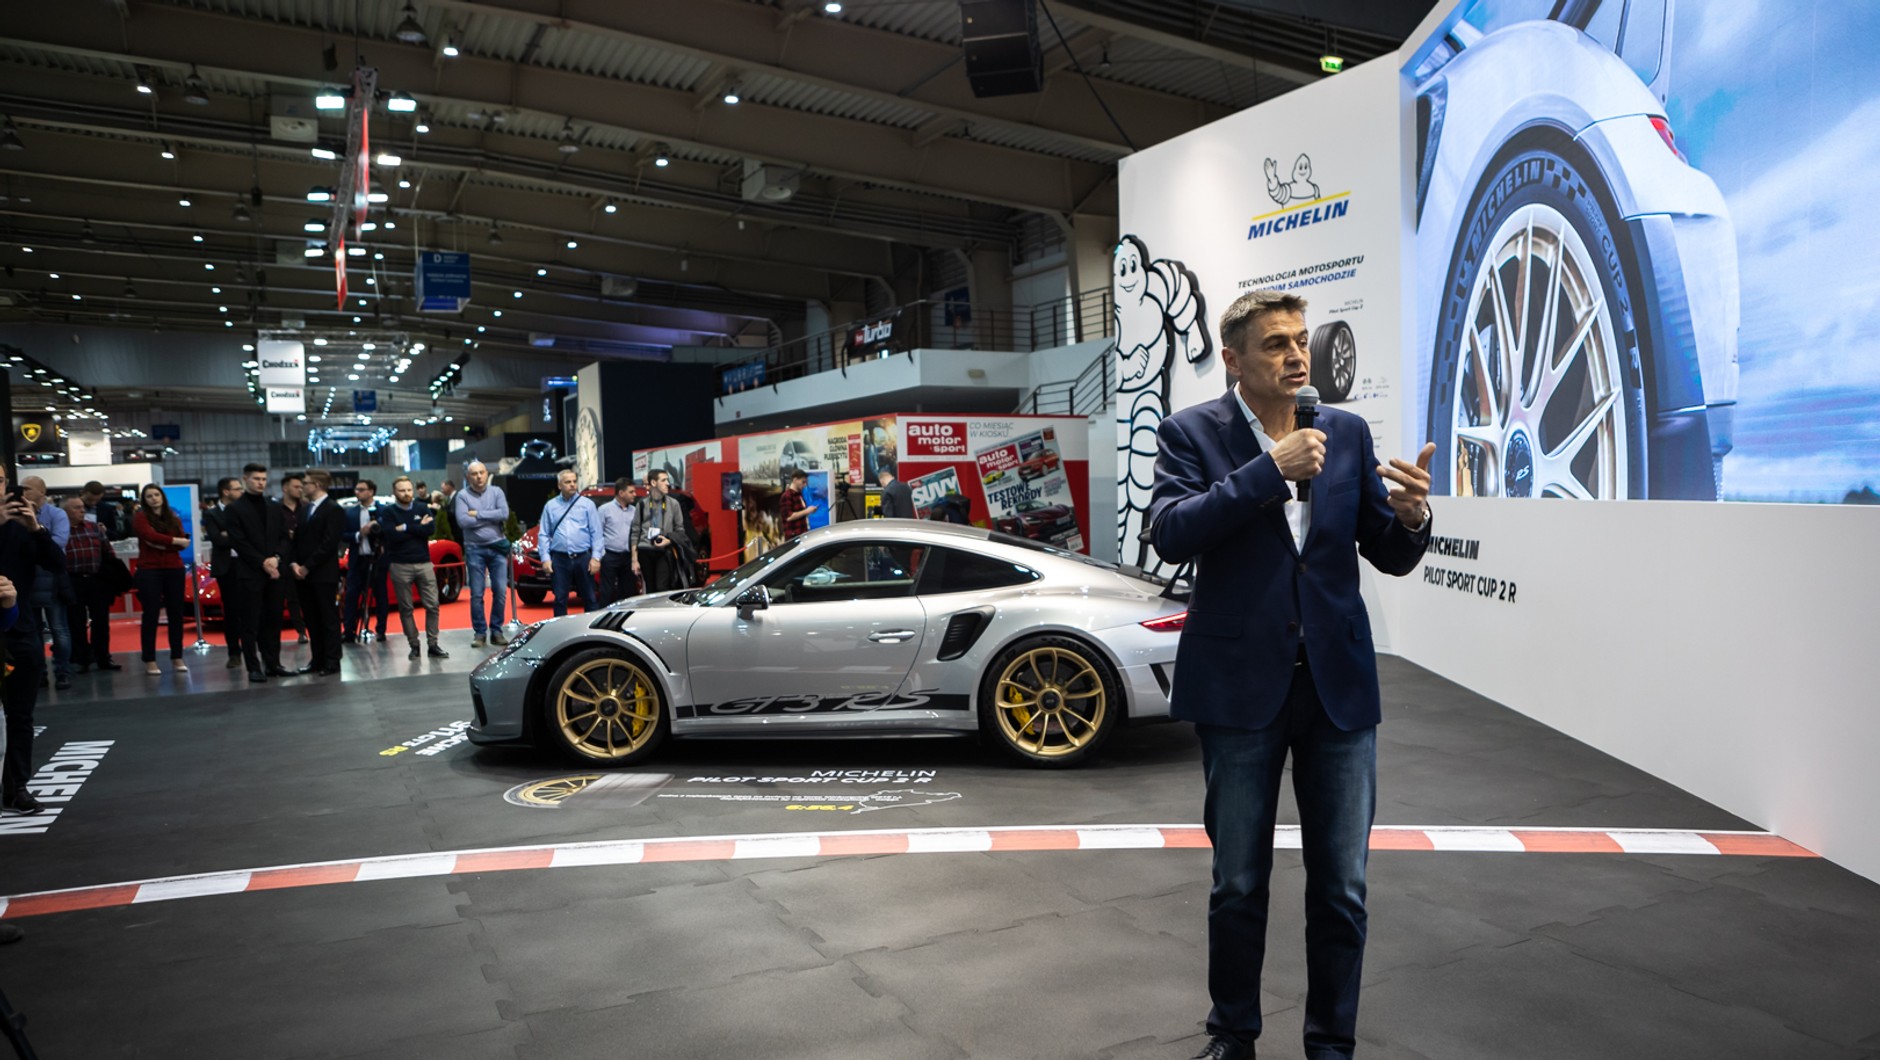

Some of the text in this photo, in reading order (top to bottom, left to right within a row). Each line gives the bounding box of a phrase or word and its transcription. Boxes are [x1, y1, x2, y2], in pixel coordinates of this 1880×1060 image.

[1248, 200, 1349, 240] MICHELIN
[1471, 160, 1541, 258] MICHELIN
[1238, 255, 1365, 290] TECHNOLOGIA MOTOSPORTU
[1287, 268, 1357, 291] SAMOCHODZIE
[1602, 234, 1623, 290] CUP
[1618, 298, 1630, 316] 2
[908, 424, 953, 436] auto
[918, 435, 962, 445] motor
[932, 445, 966, 453] sport
[979, 449, 1009, 465] auto
[987, 455, 1015, 469] motor
[911, 475, 957, 506] SUVY
[987, 482, 1031, 505] TESTOWE
[1001, 487, 1043, 511] REKORDY
[1424, 565, 1517, 604] PILOT SPORT CUP 2 R
[710, 688, 940, 714] GT3 RS
